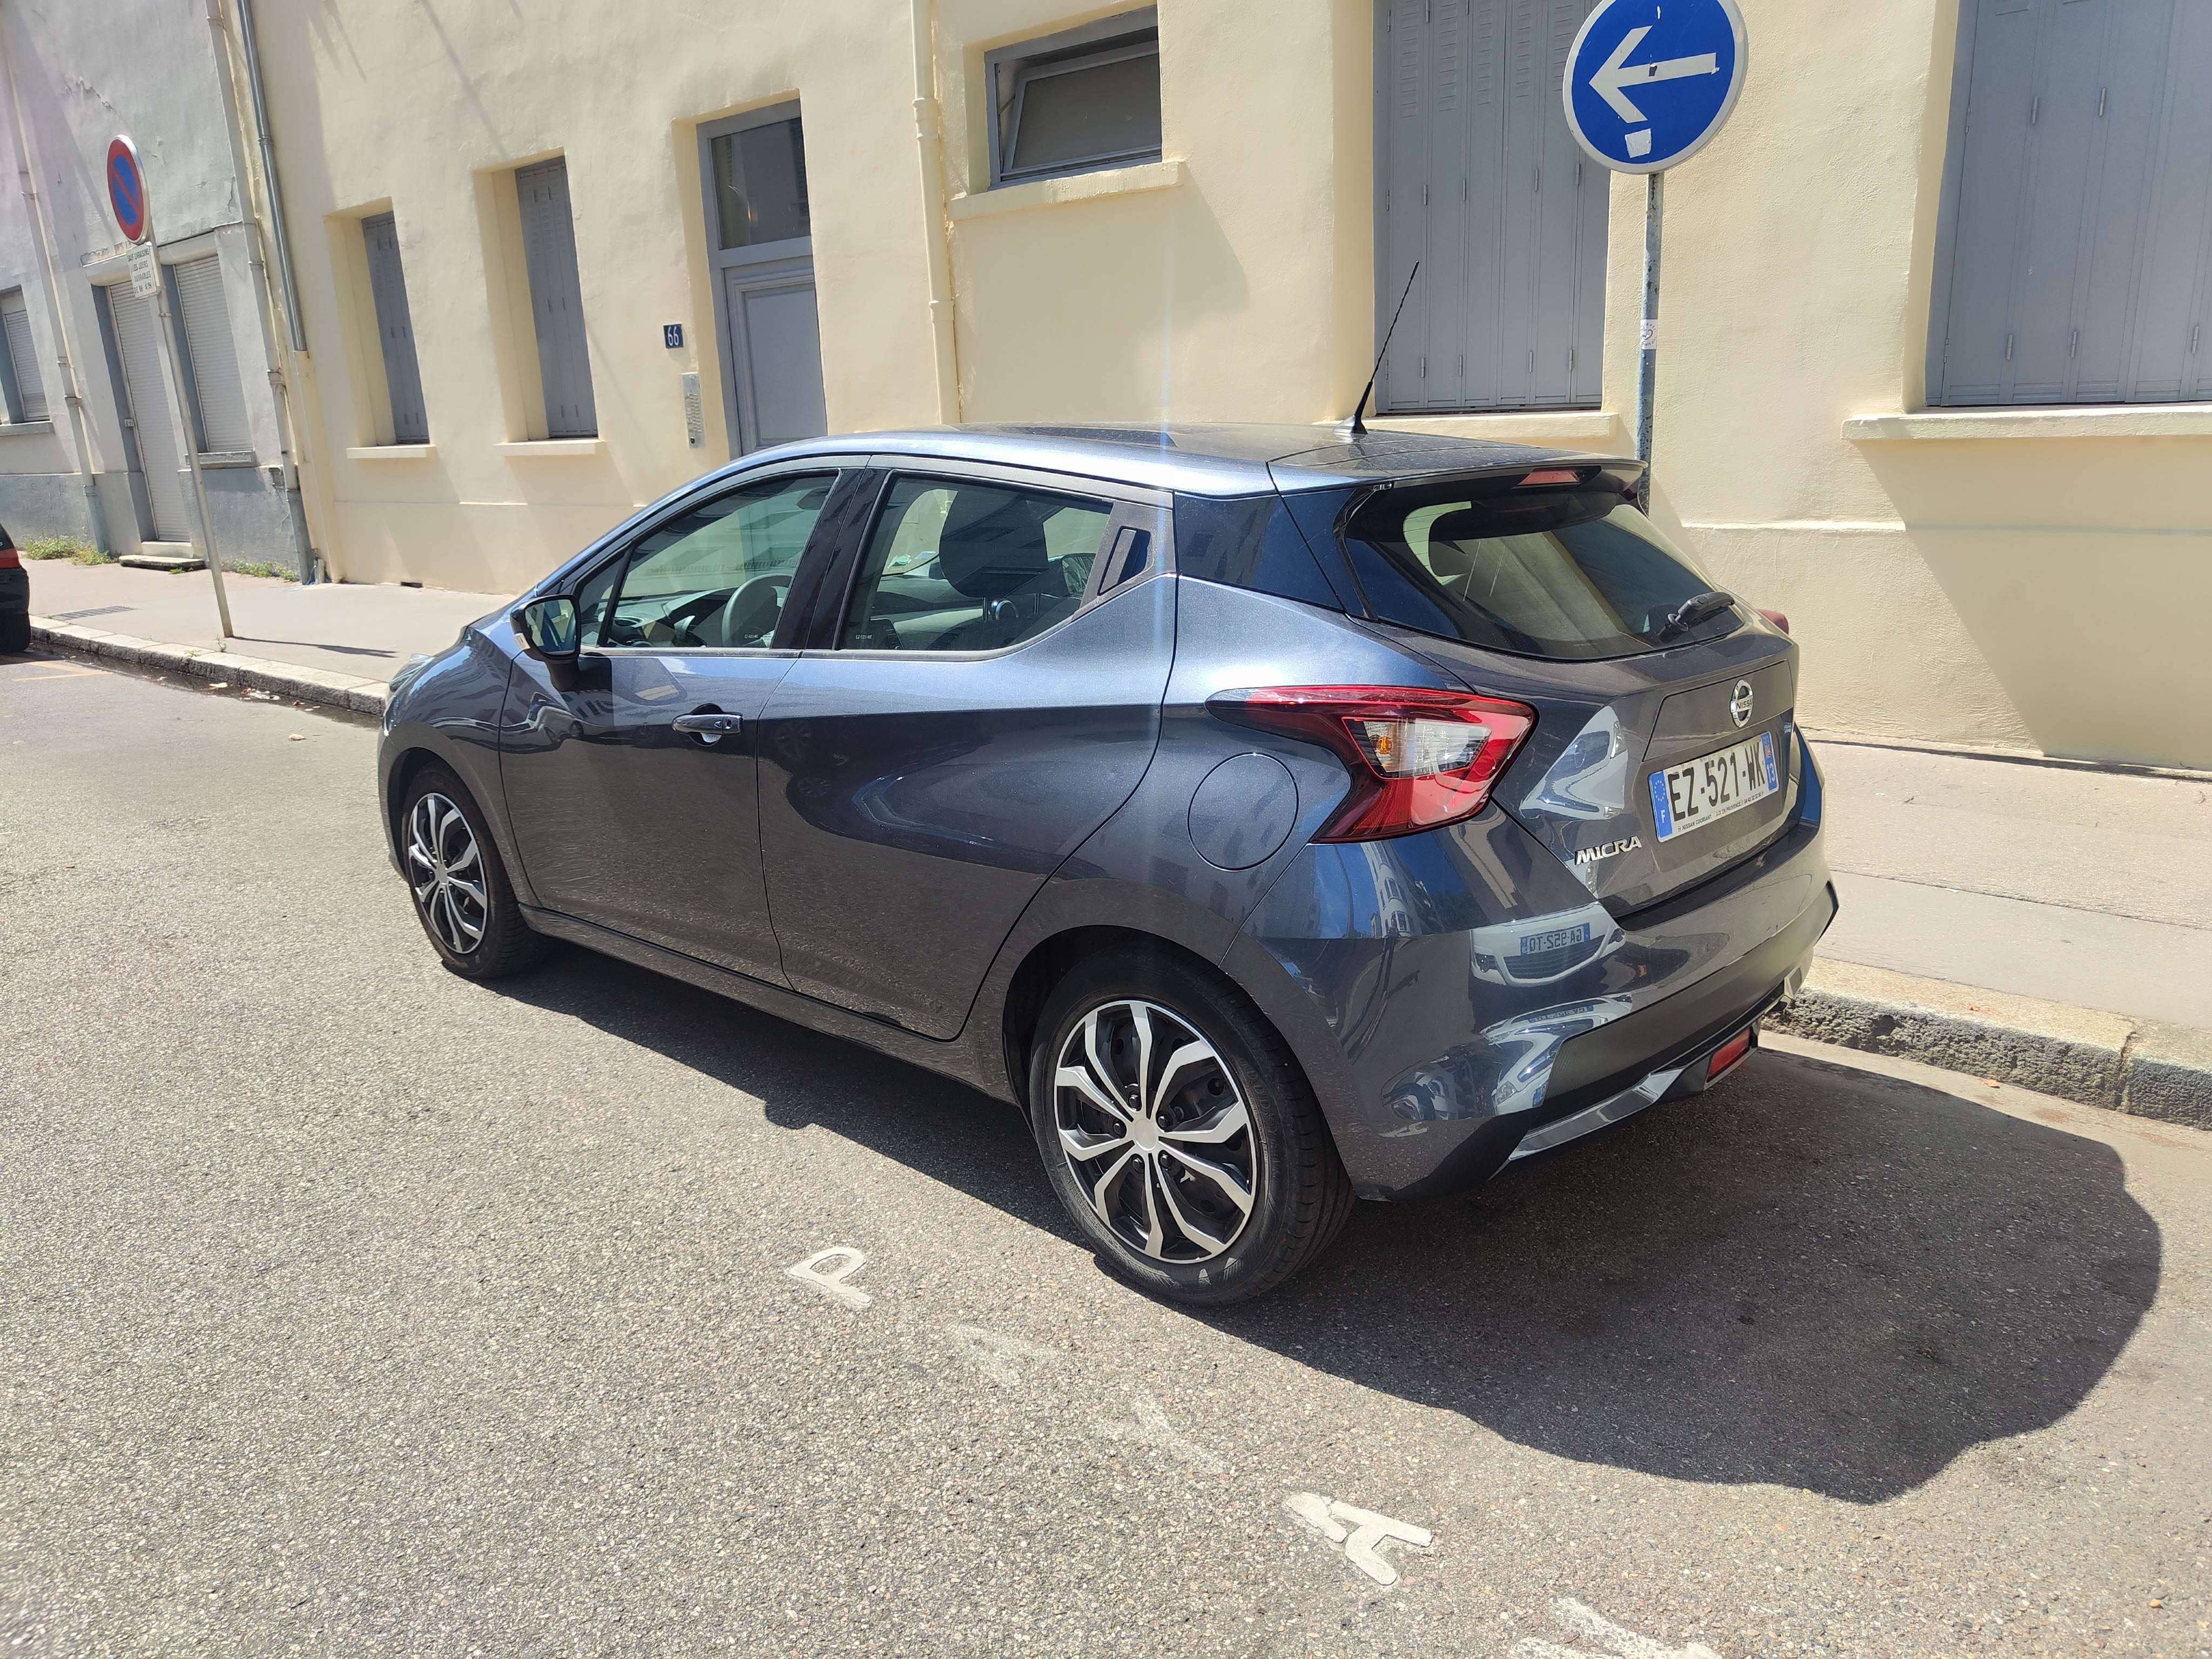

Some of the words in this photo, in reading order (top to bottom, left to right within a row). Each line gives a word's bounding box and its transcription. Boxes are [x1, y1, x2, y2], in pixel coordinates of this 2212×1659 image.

[667, 326, 679, 346] 66
[1736, 699, 1754, 710] NISSA
[1767, 763, 1775, 783] 13
[1661, 809, 1665, 824] F
[1682, 821, 1695, 830] NISSAN
[1575, 836, 1642, 865] MICRA
